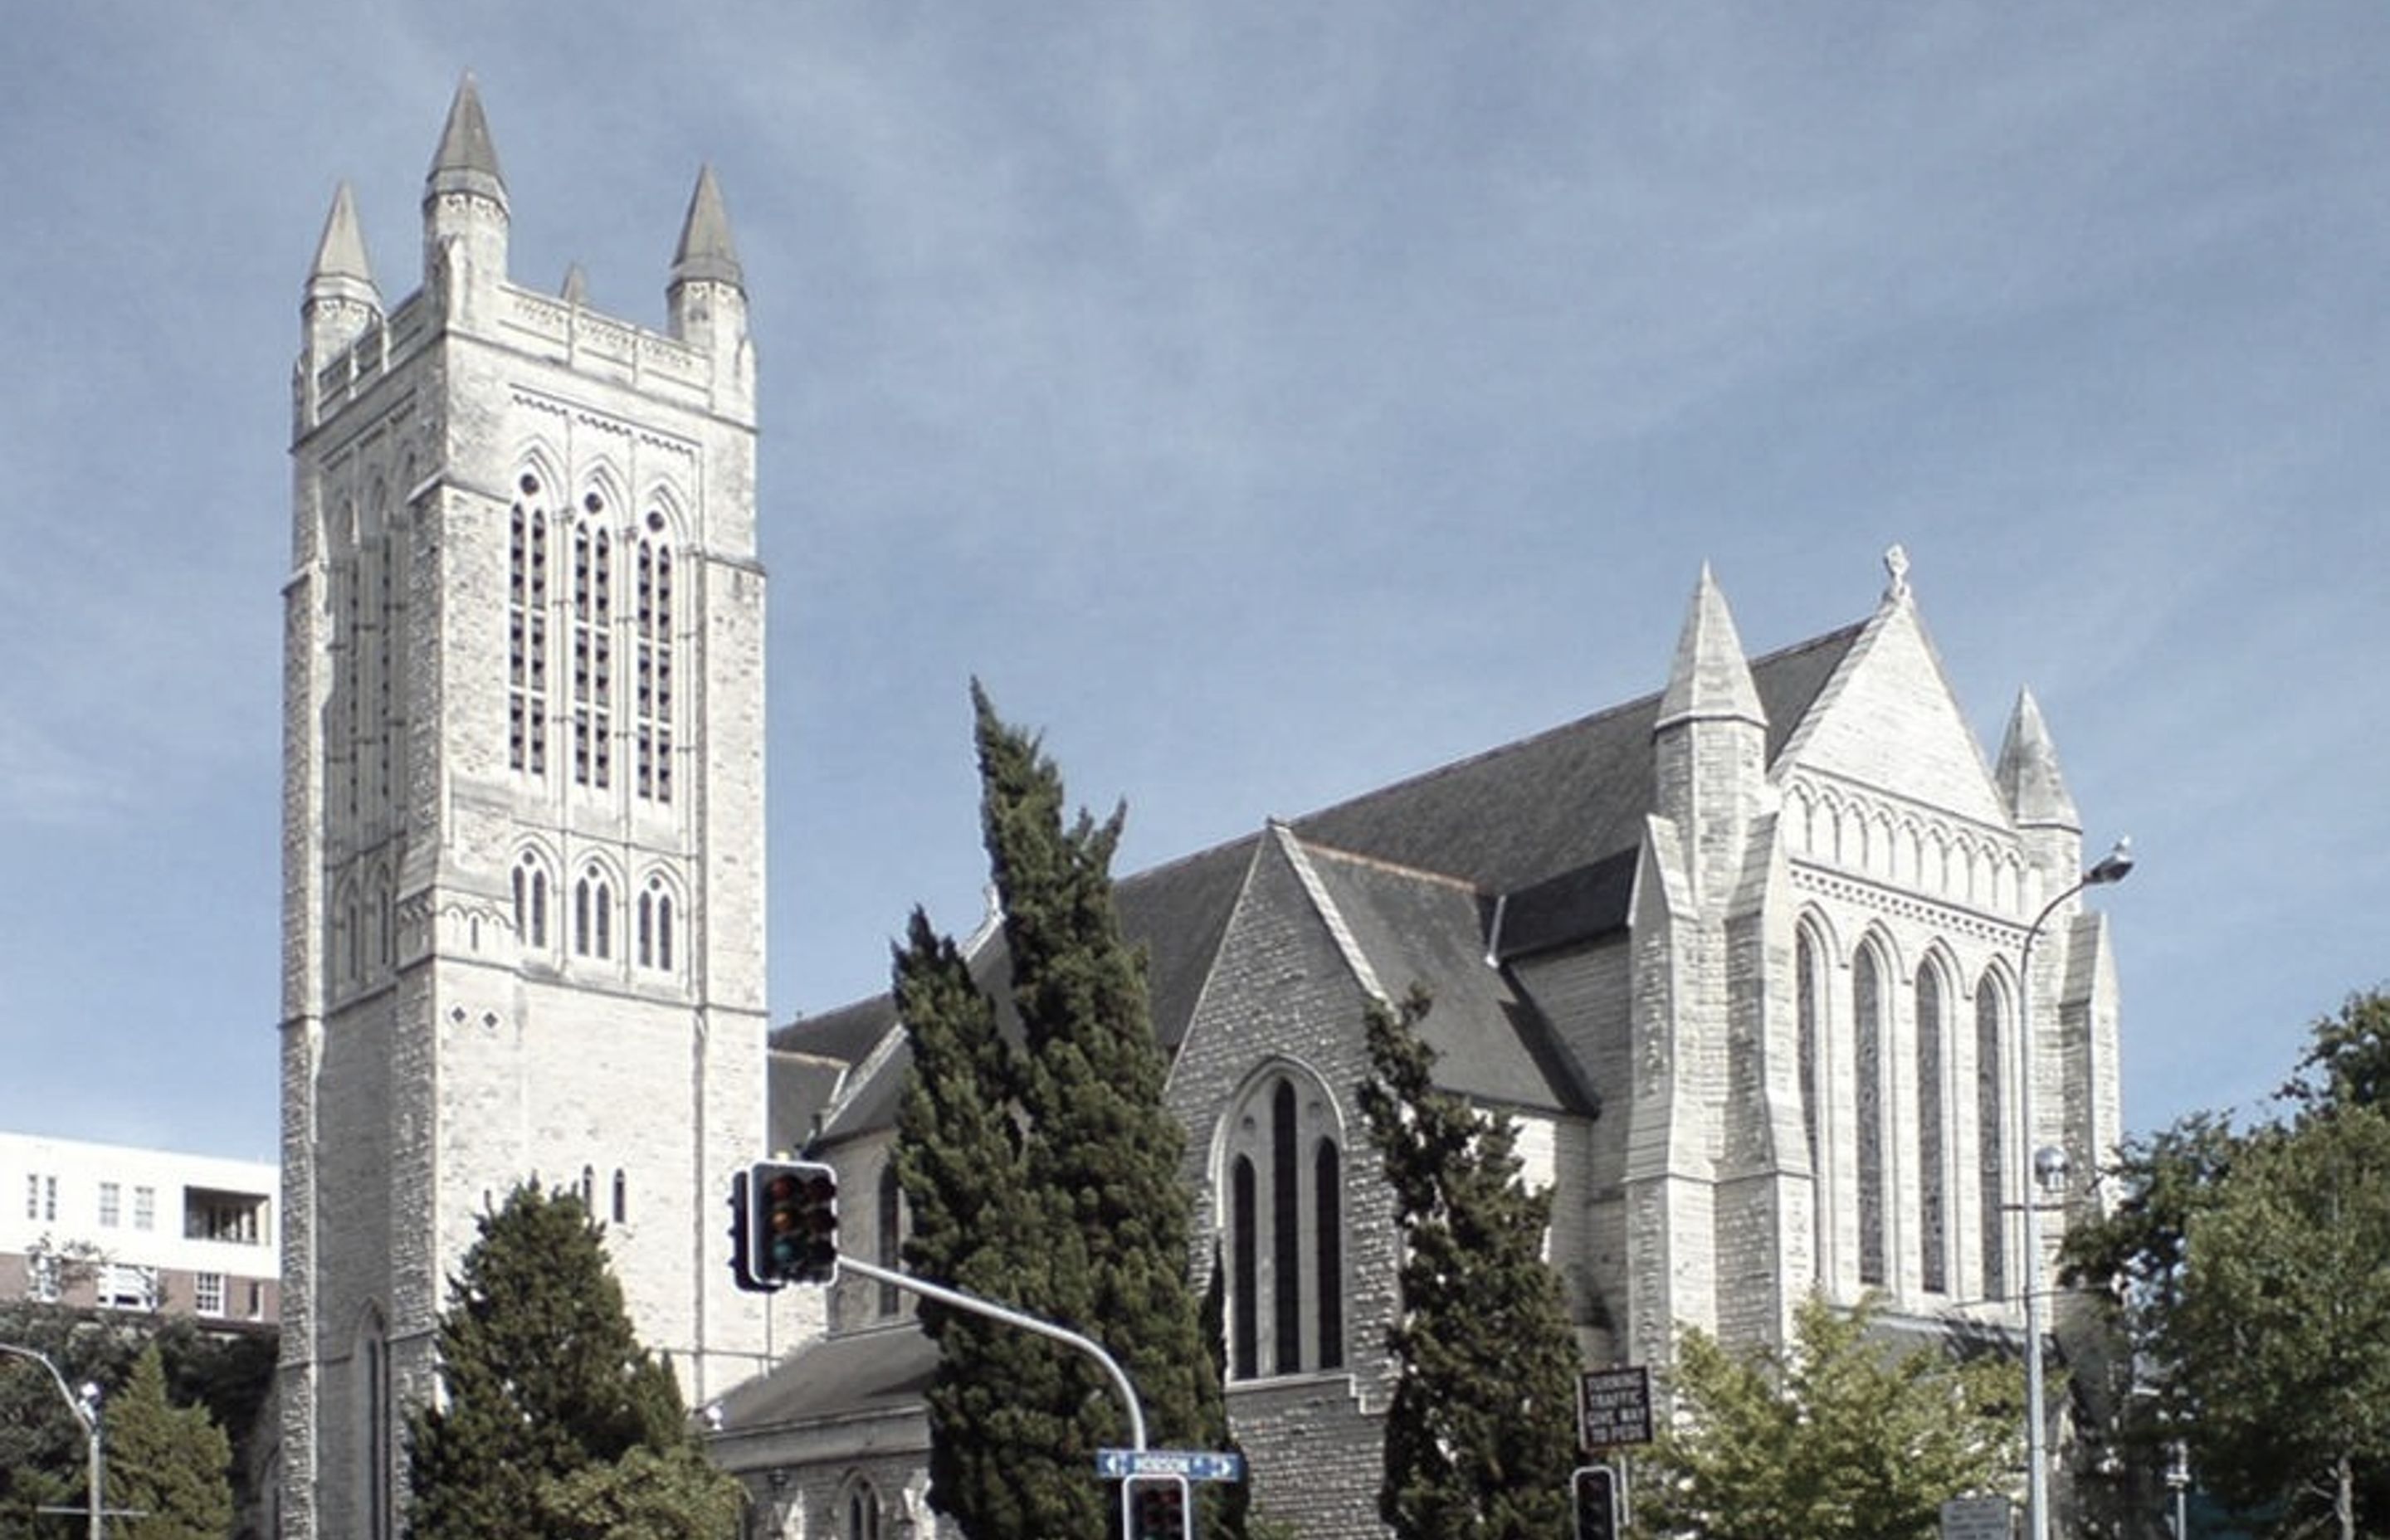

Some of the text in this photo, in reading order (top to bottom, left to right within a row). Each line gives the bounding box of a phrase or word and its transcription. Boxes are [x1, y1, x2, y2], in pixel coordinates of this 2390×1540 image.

[1590, 1391, 1641, 1408] TRAFFIC
[1587, 1406, 1646, 1425] GIVE WAY
[1593, 1427, 1607, 1443] TO
